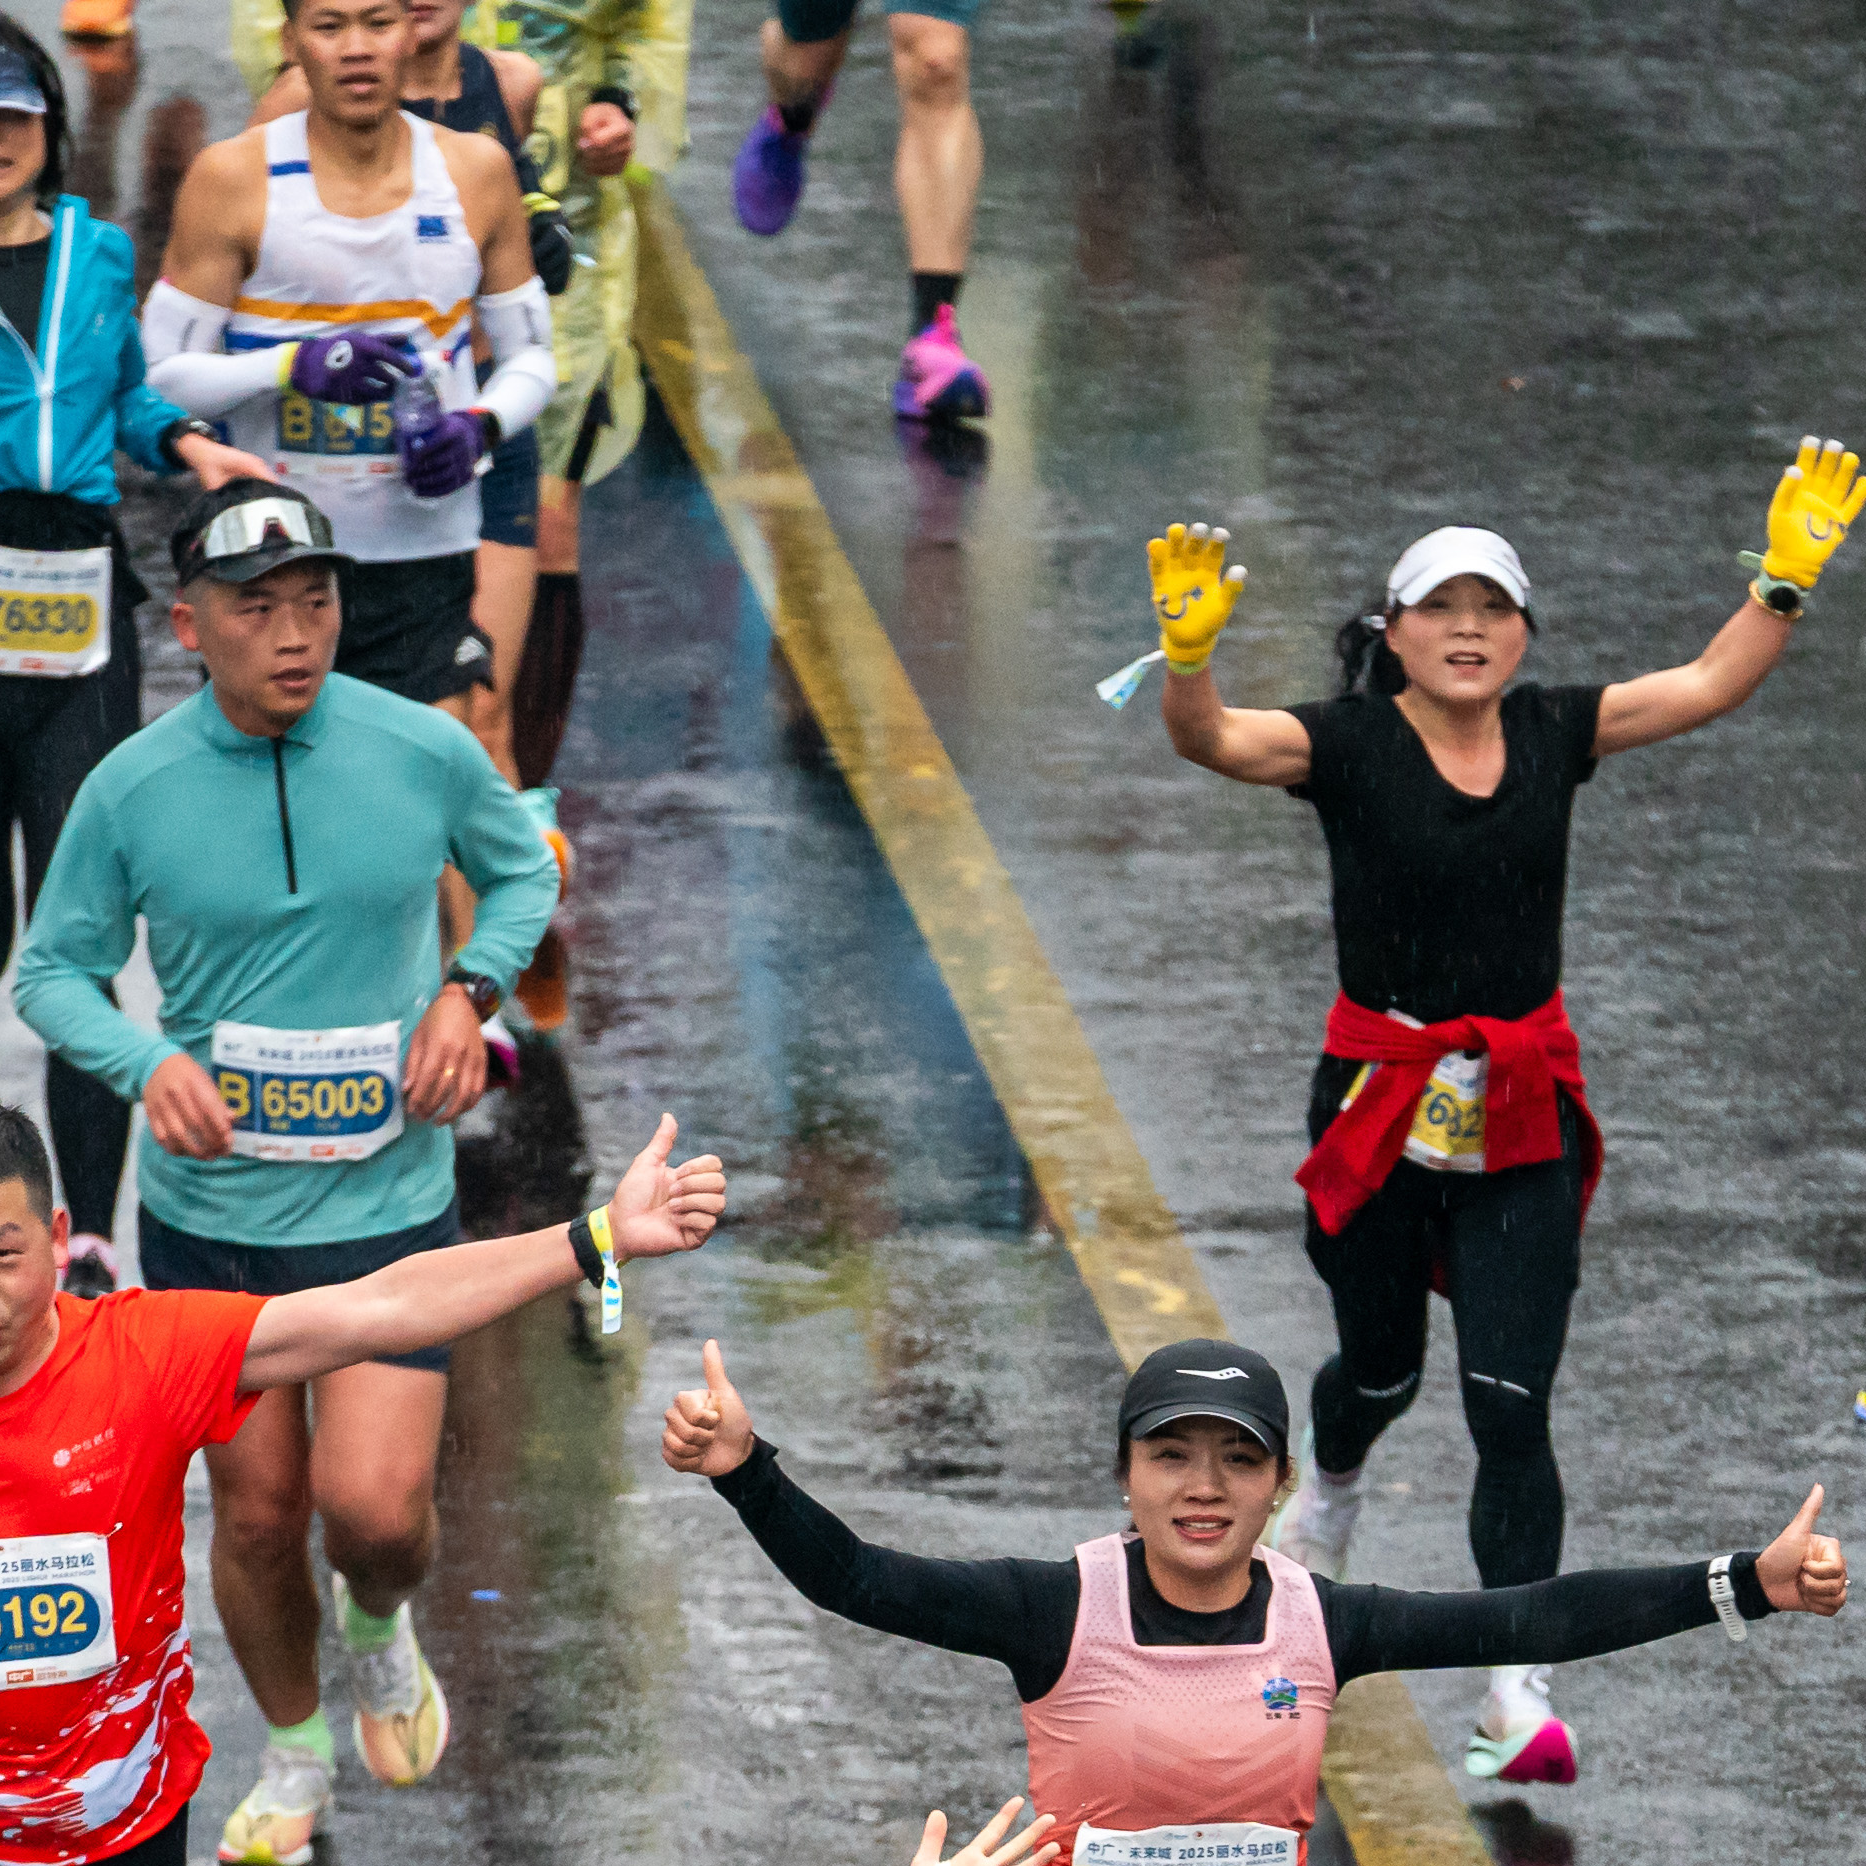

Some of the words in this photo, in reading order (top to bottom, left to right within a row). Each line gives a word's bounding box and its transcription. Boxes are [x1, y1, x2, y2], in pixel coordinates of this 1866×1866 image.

[284, 398, 313, 440] B
[219, 1071, 251, 1119] B
[262, 1076, 385, 1119] 65003
[1178, 1841, 1288, 1860] 2025丽水马拉松
